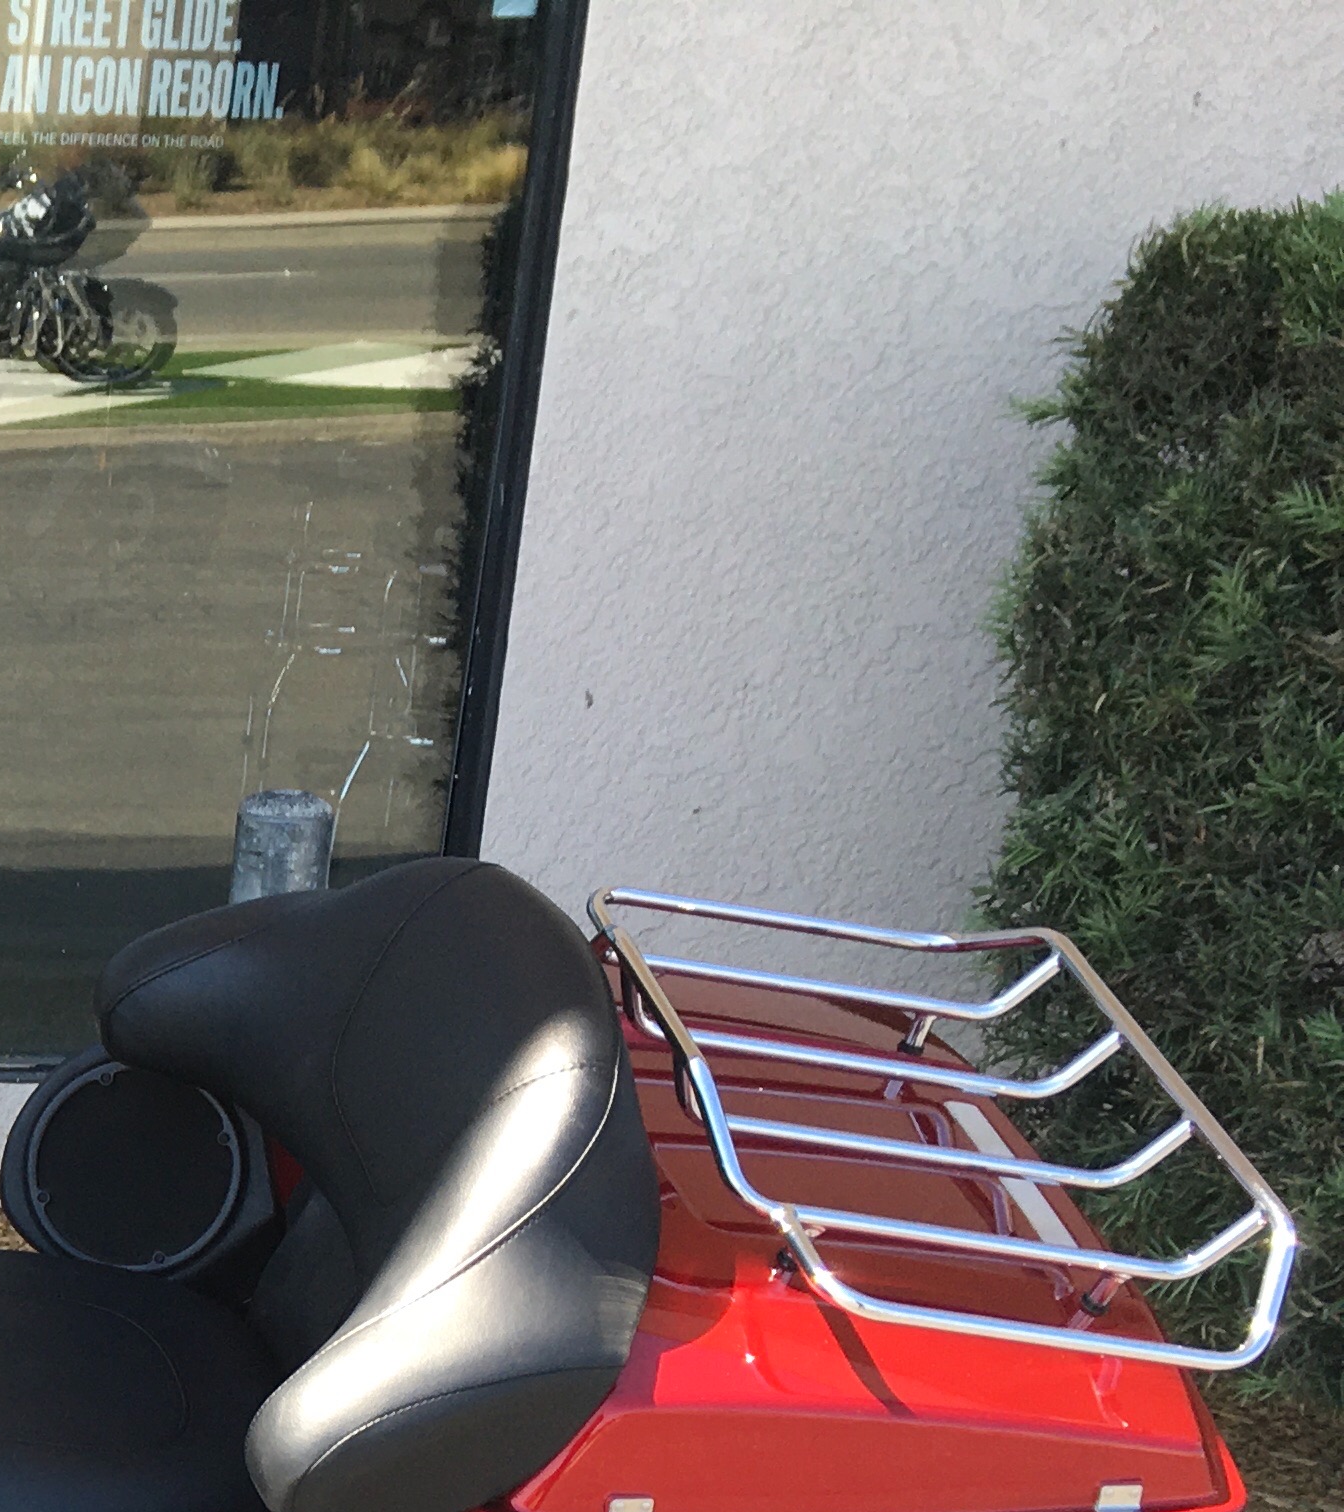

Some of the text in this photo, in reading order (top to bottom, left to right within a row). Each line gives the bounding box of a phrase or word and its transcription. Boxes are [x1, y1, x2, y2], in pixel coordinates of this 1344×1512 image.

[7, 0, 242, 53] STREET GLIDE.
[0, 54, 284, 119] AN ICON REBORN.
[32, 131, 56, 146] THE
[60, 131, 139, 147] DIFFERENCE
[141, 133, 161, 148] ON
[164, 133, 187, 148] THE
[190, 134, 224, 149] ROAD
